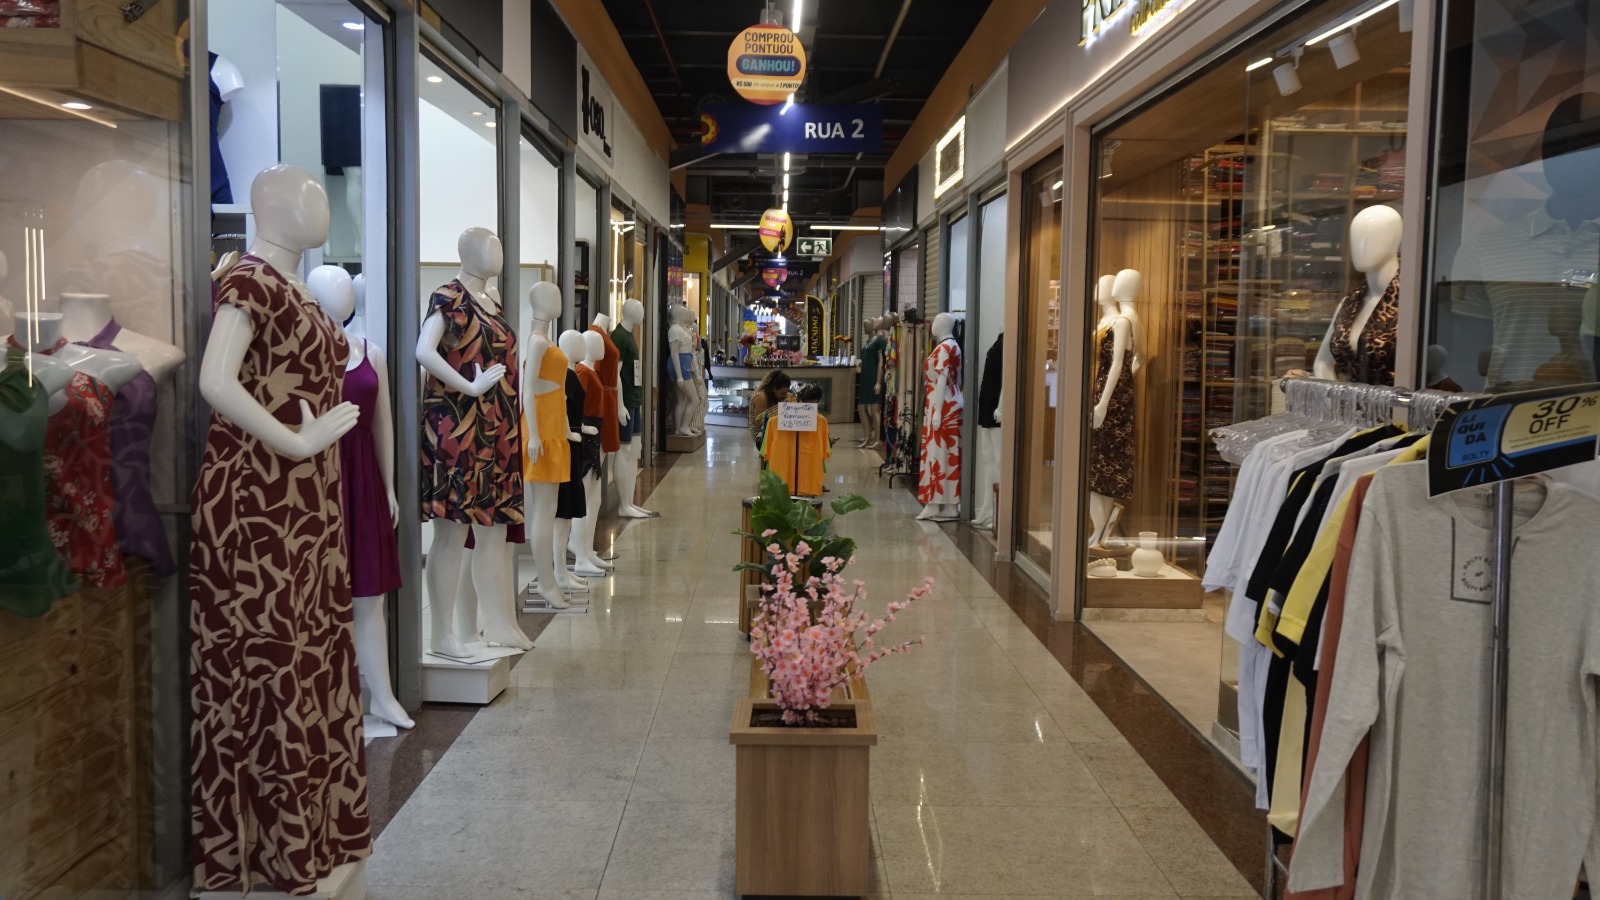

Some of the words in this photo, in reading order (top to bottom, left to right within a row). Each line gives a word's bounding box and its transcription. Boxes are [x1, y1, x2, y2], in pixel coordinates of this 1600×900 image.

[744, 32, 794, 44] COMPROU
[744, 43, 794, 54] PONTUOU
[741, 58, 796, 72] GANHOU!
[804, 121, 845, 139] RUA
[851, 118, 865, 138] 2
[1461, 413, 1477, 424] LI
[1529, 413, 1571, 434] OFF
[1457, 420, 1486, 435] QUI
[1464, 431, 1487, 446] DA
[1461, 450, 1490, 461] ROLTY
